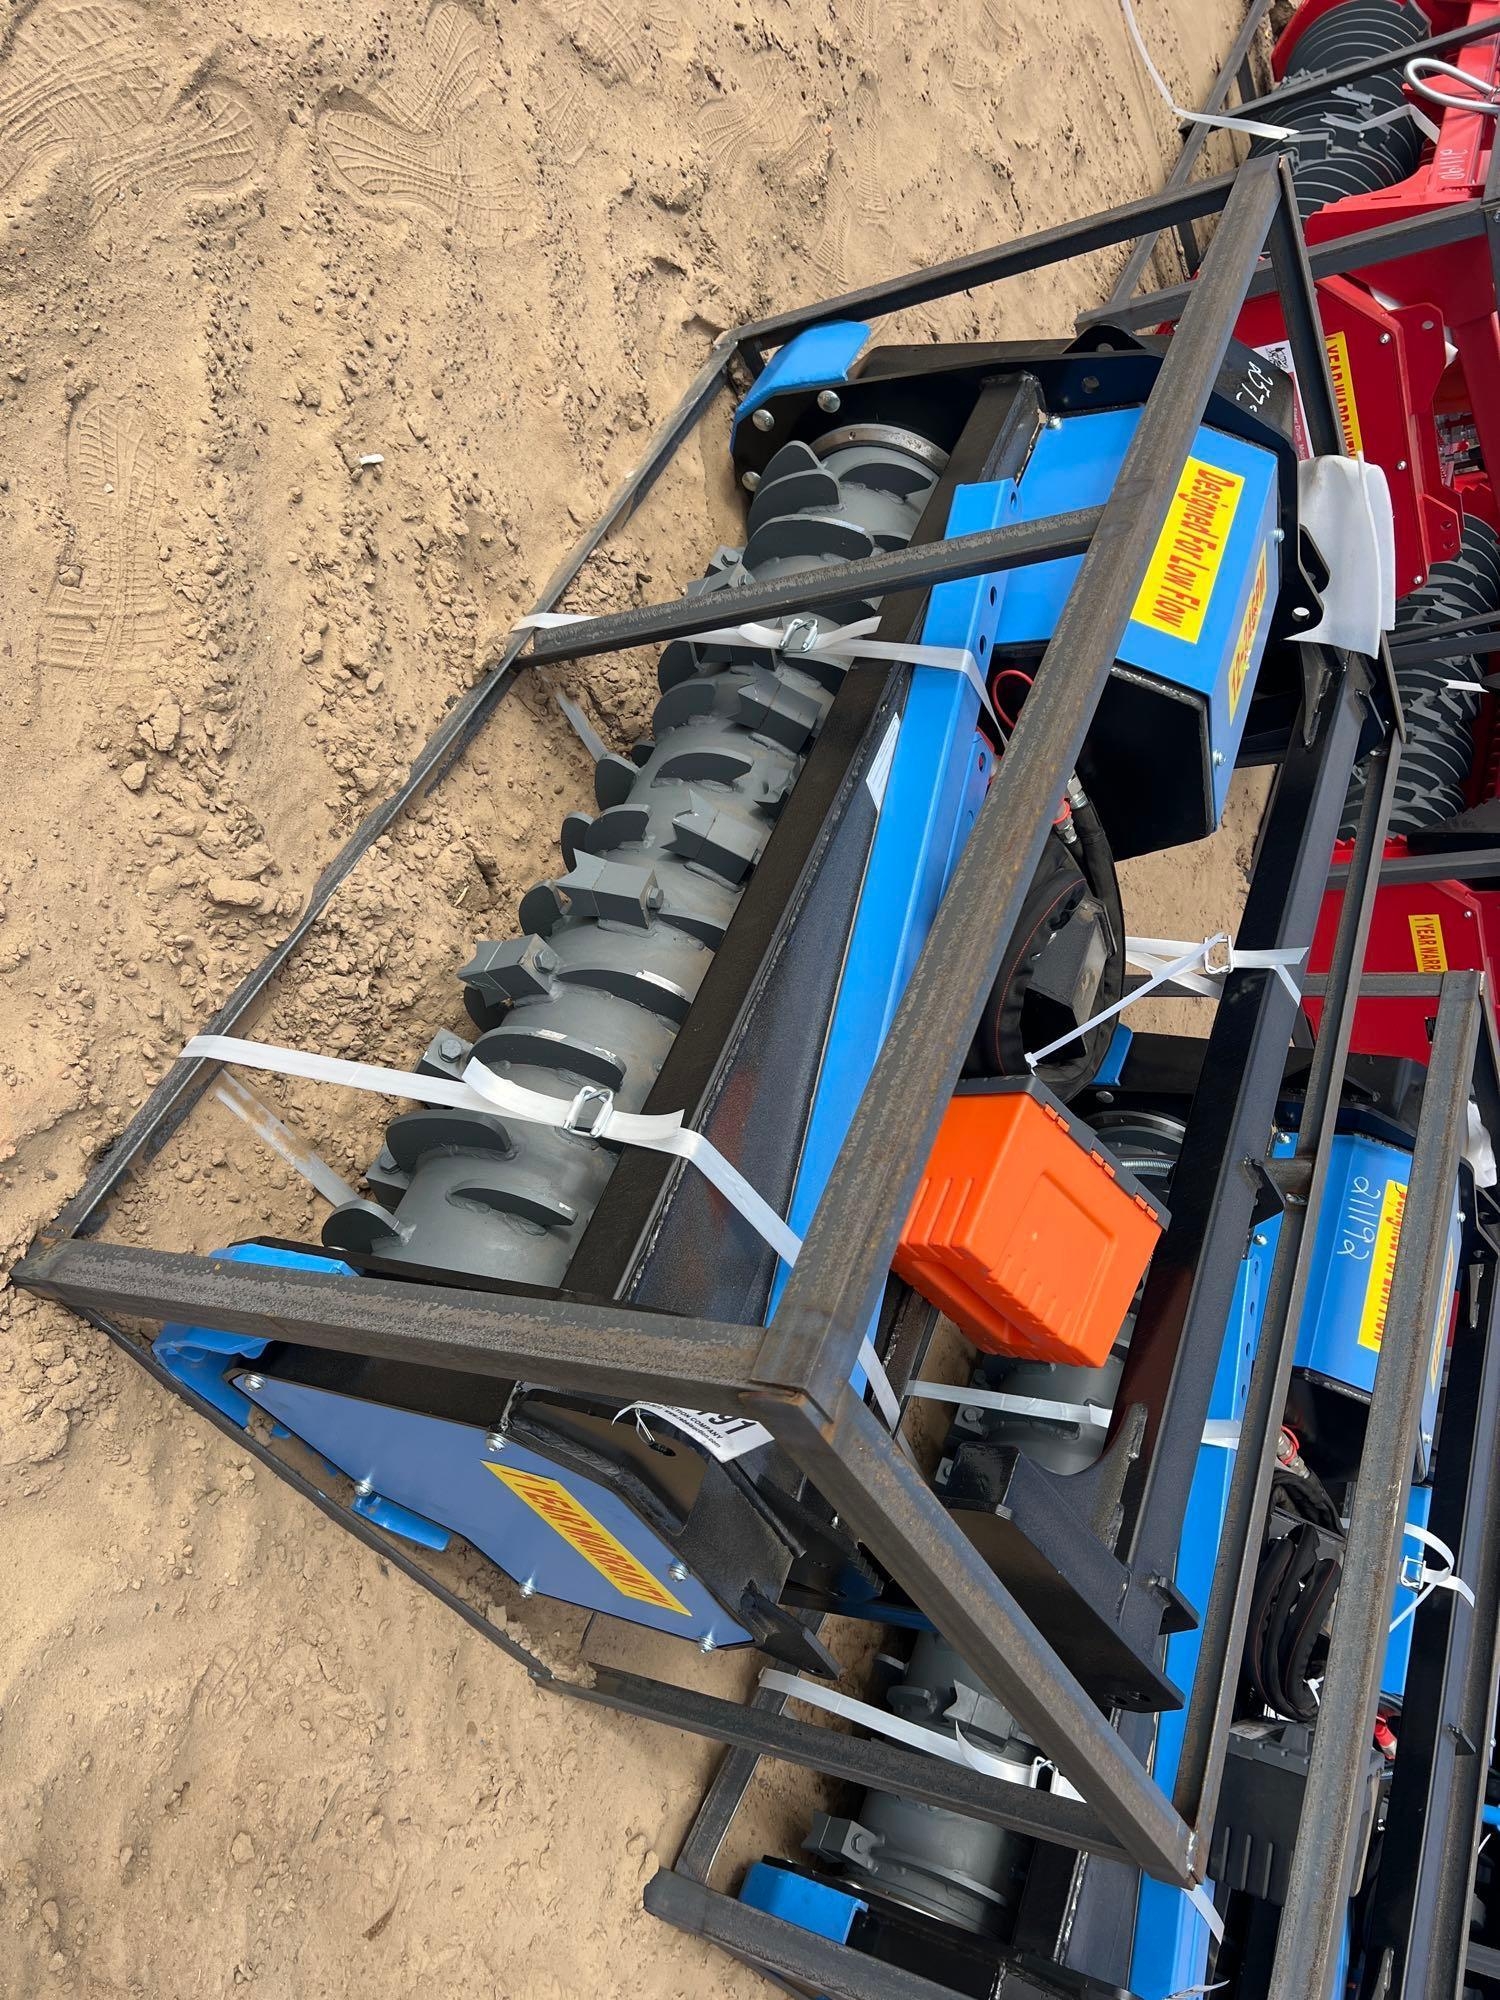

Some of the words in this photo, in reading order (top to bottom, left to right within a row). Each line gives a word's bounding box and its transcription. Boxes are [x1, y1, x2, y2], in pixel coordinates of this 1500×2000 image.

[1178, 468, 1236, 540] Designed
[1173, 529, 1217, 561] For
[1163, 554, 1210, 591] Low
[1152, 585, 1201, 628] Flow
[1415, 923, 1437, 946] YEAR
[1337, 1176, 1381, 1260] 211192
[514, 1483, 592, 1529] YEAR
[558, 1523, 674, 1607] WARRANTY
